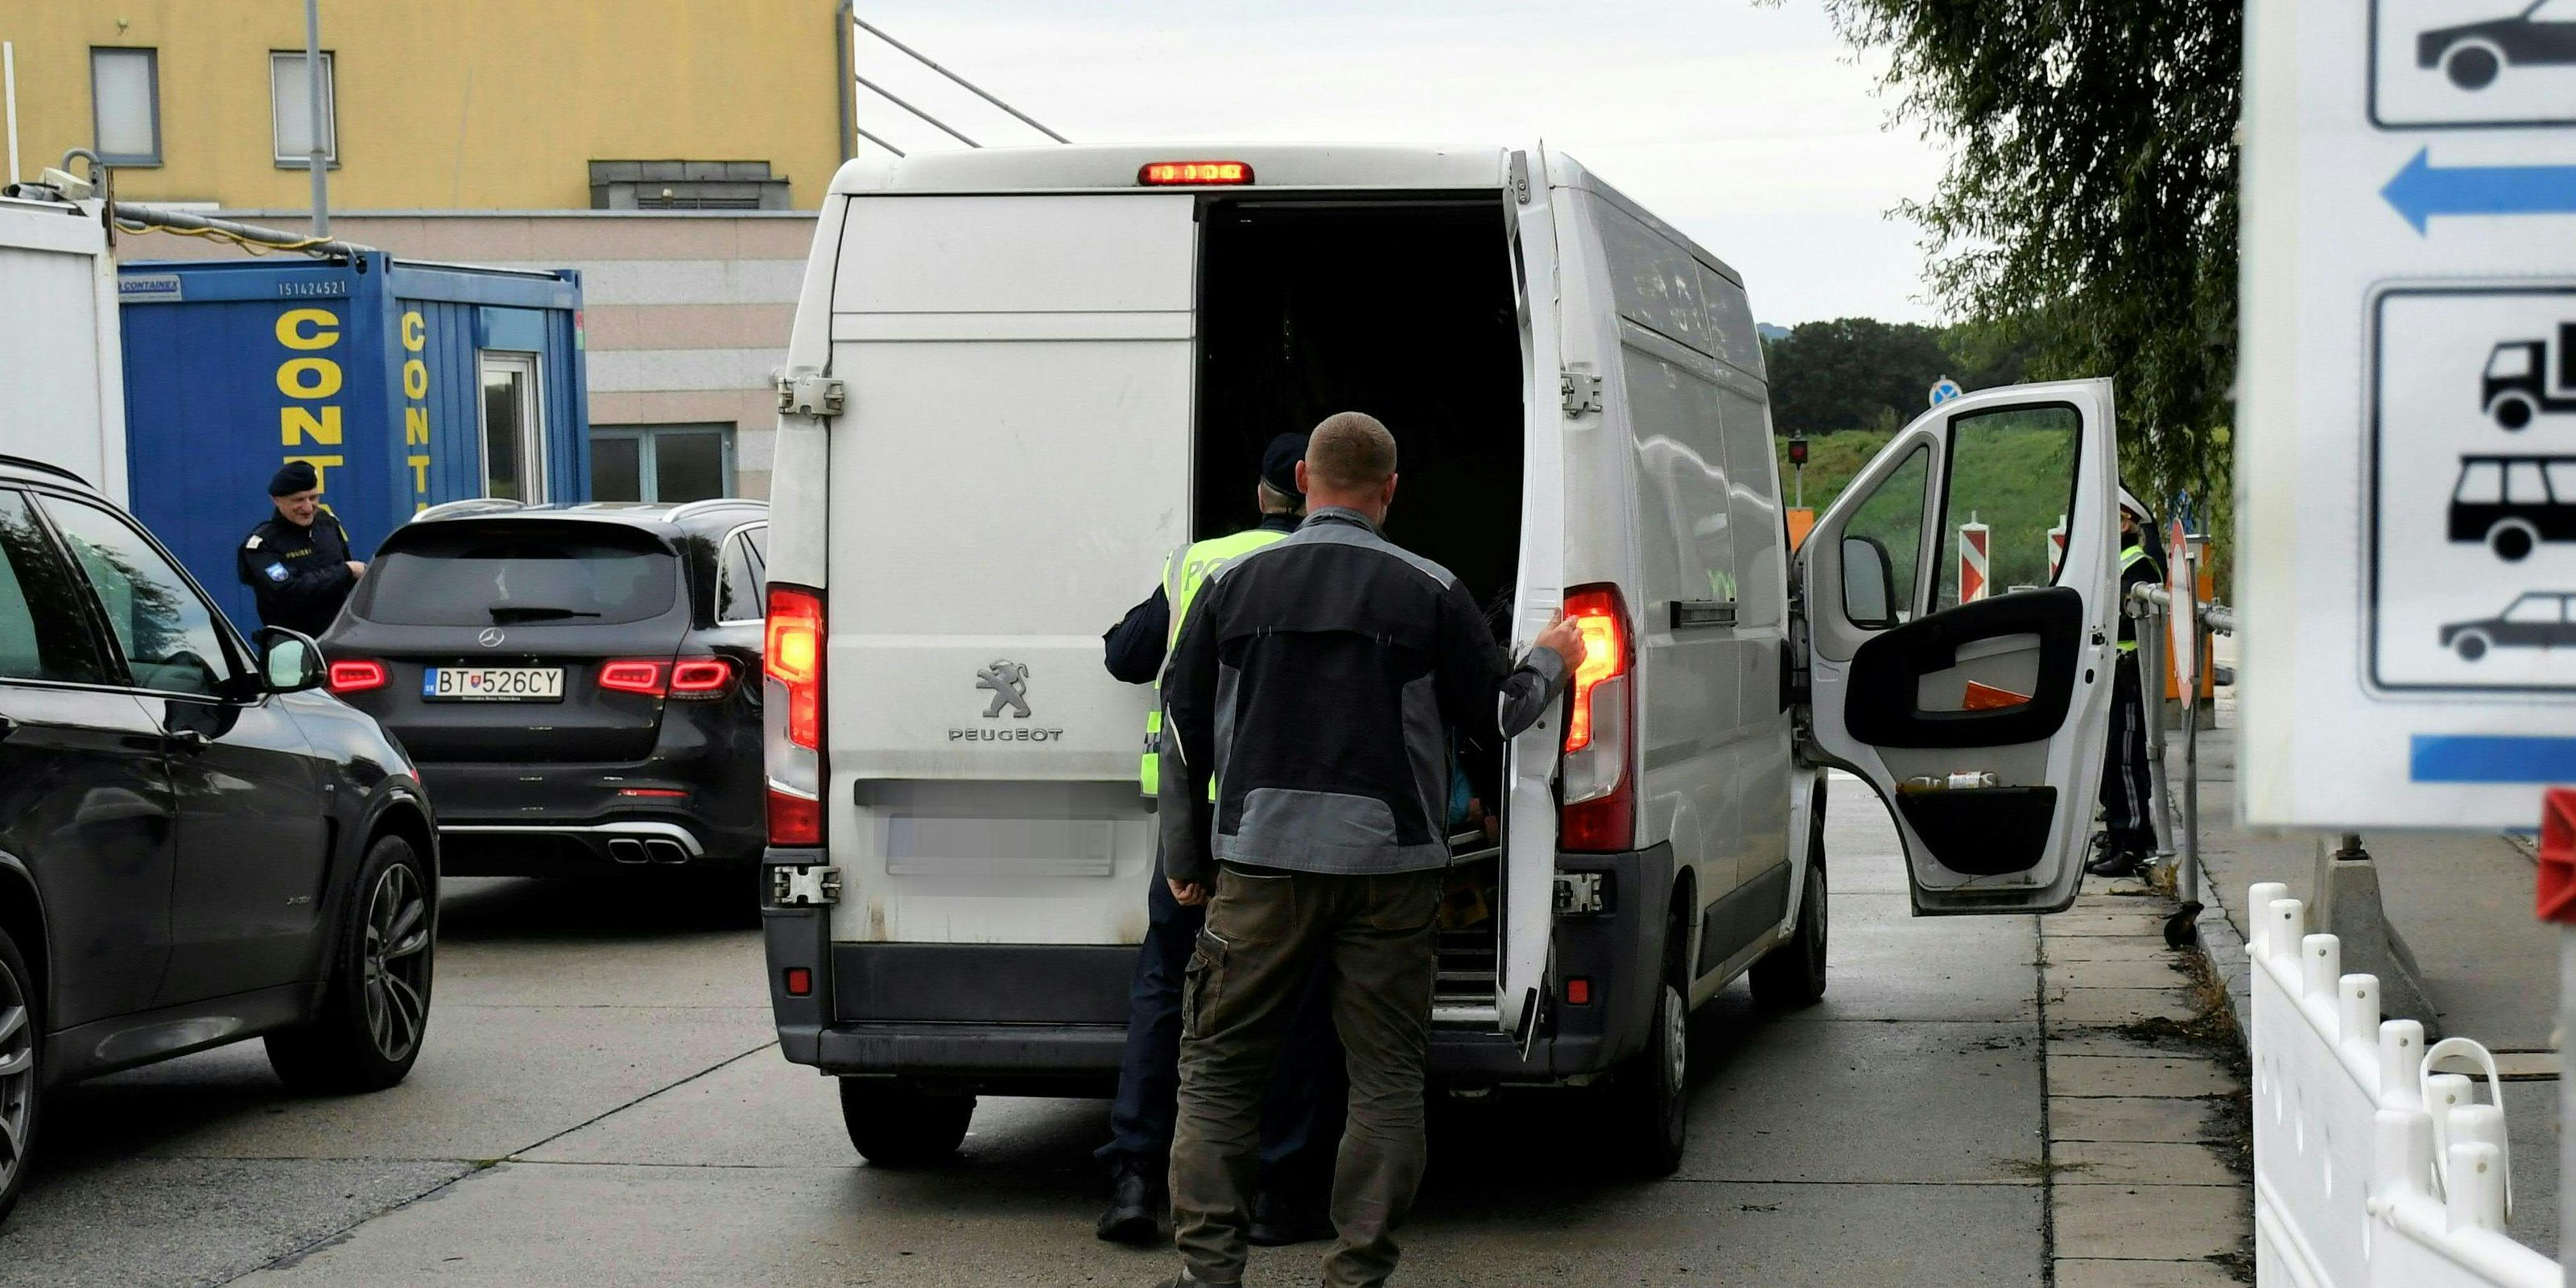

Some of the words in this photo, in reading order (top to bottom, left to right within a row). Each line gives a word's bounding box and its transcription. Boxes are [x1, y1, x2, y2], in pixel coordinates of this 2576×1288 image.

[124, 280, 178, 291] CONTAINEX
[279, 281, 345, 295] 151424521
[402, 311, 431, 514] CONT
[275, 308, 349, 542] CONT
[948, 728, 1063, 741] PEUGEOT
